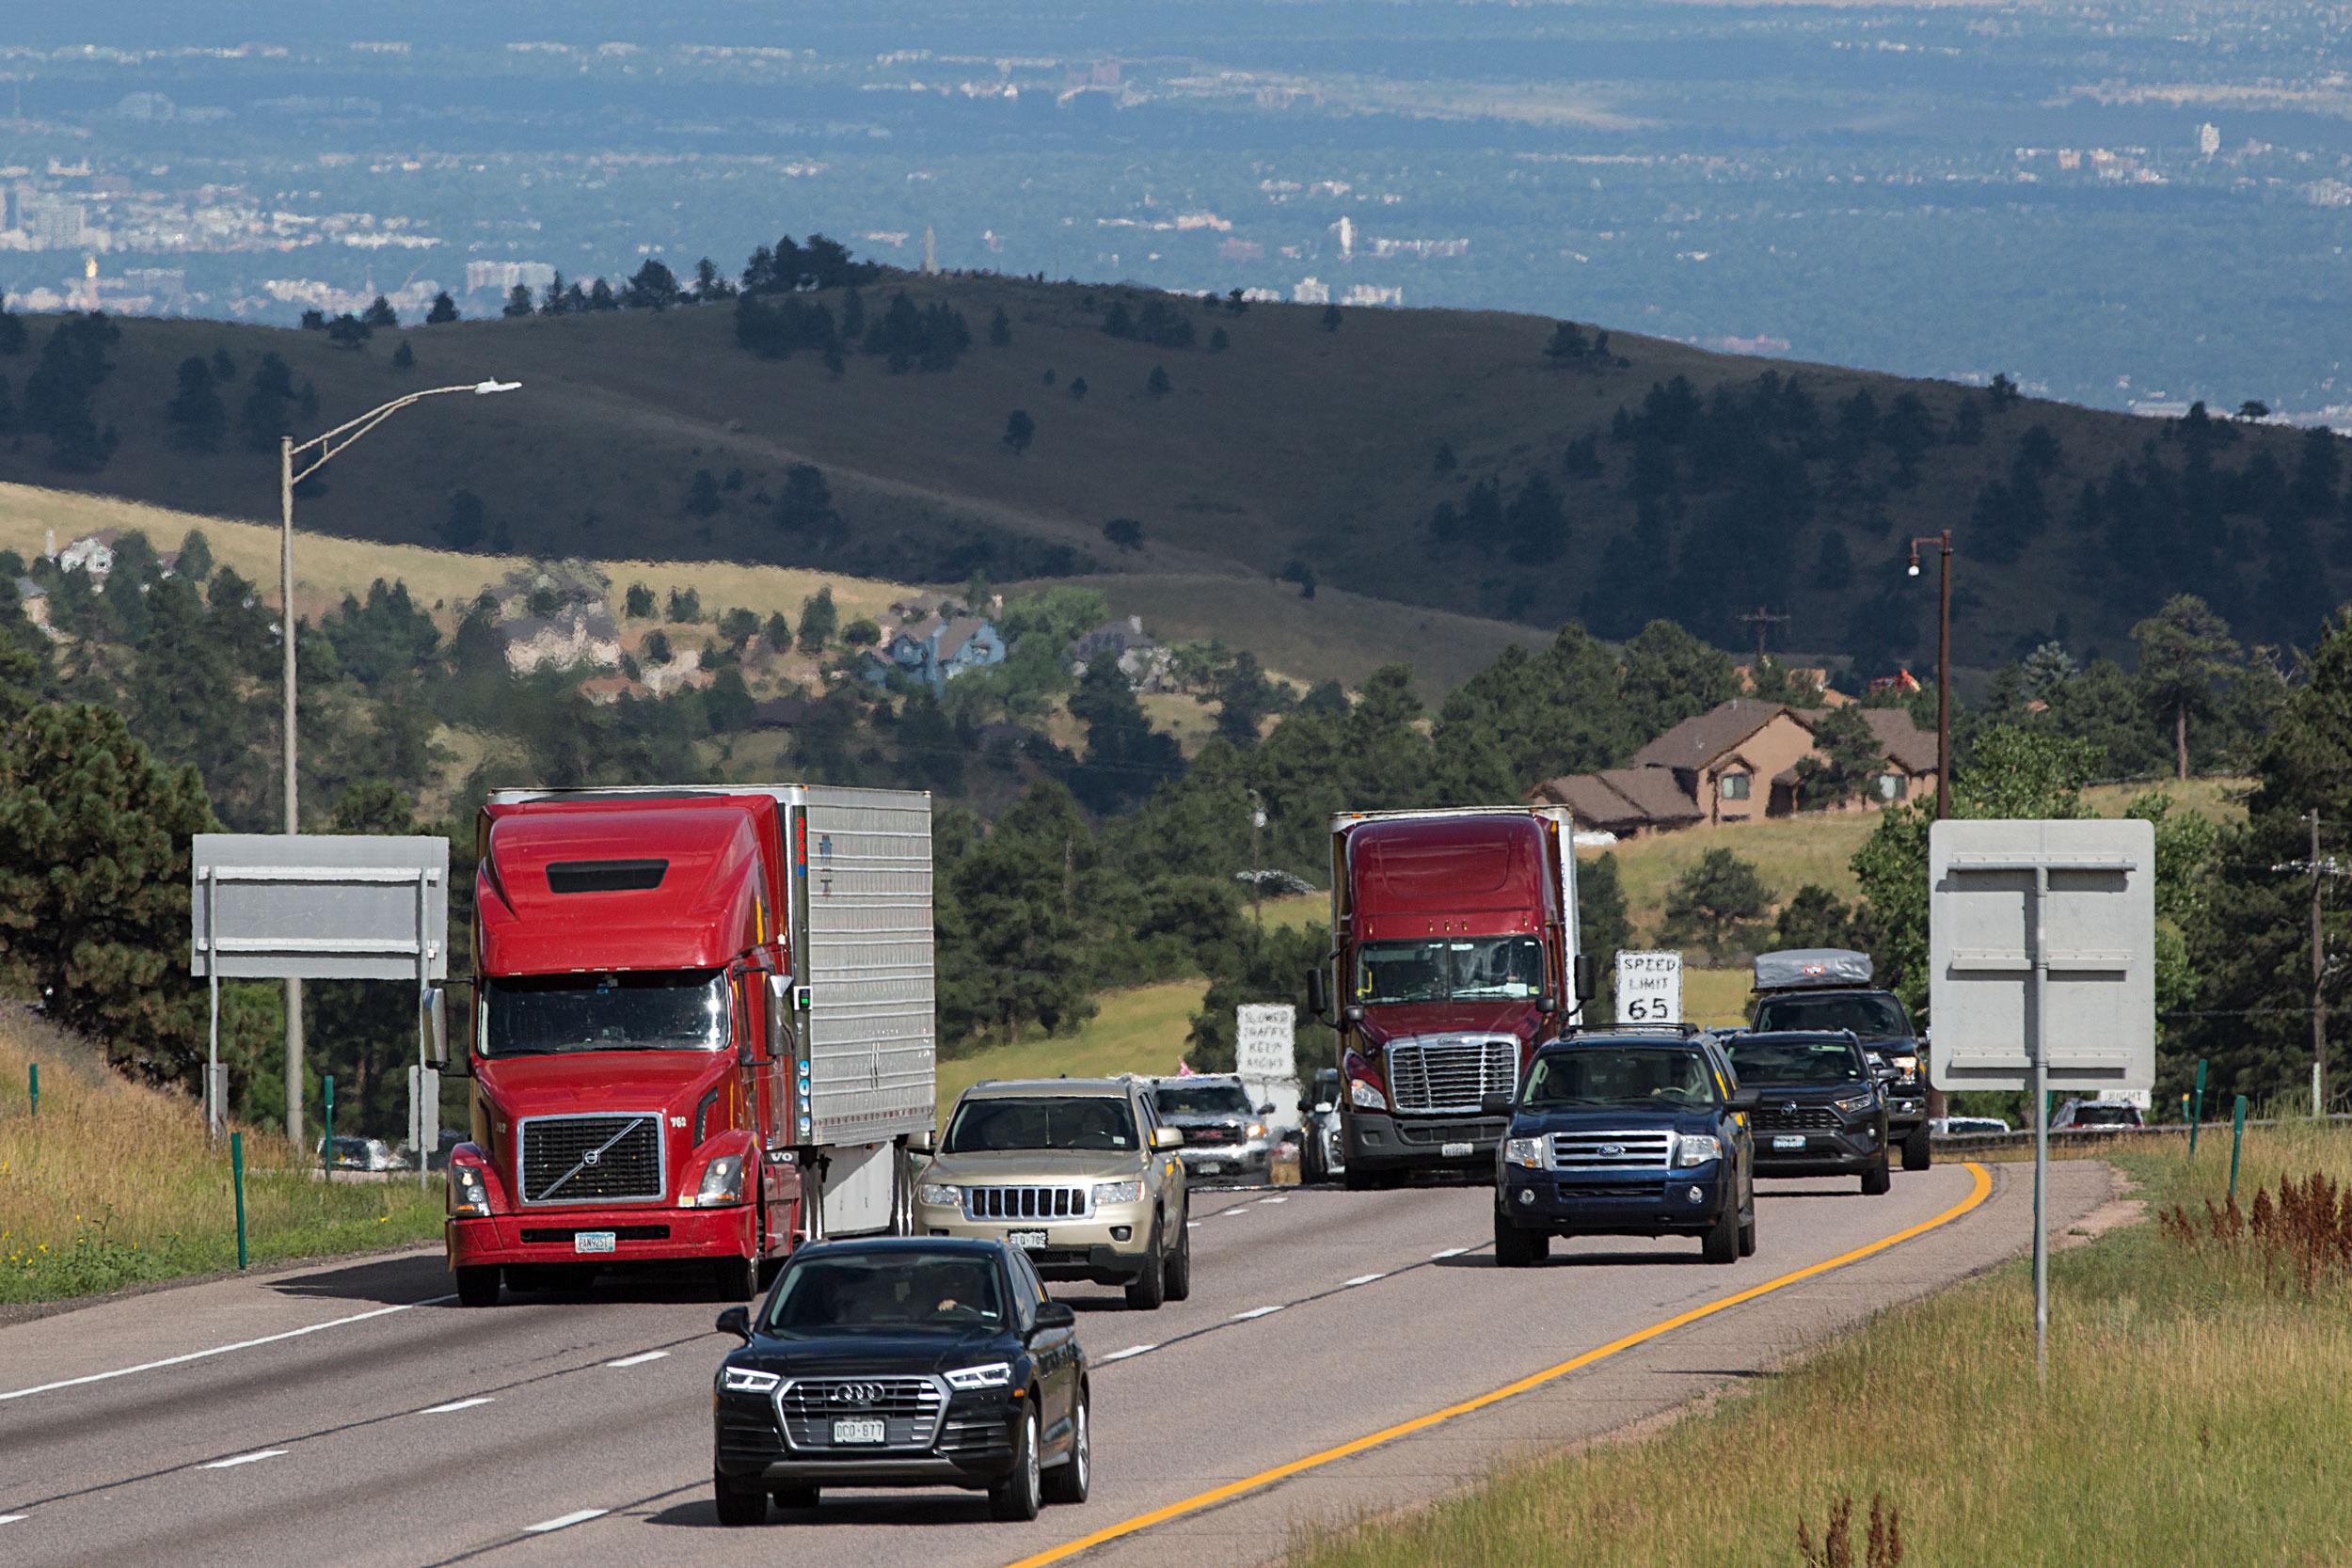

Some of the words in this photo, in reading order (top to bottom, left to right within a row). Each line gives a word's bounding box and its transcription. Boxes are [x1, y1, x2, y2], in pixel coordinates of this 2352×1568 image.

[1625, 958, 1676, 971] SPEED
[1629, 977, 1668, 990] LIMIT
[1629, 998, 1668, 1020] 65
[1249, 1041, 1281, 1053] KEEP
[799, 1059, 810, 1132] 9019
[670, 1116, 687, 1128] 762
